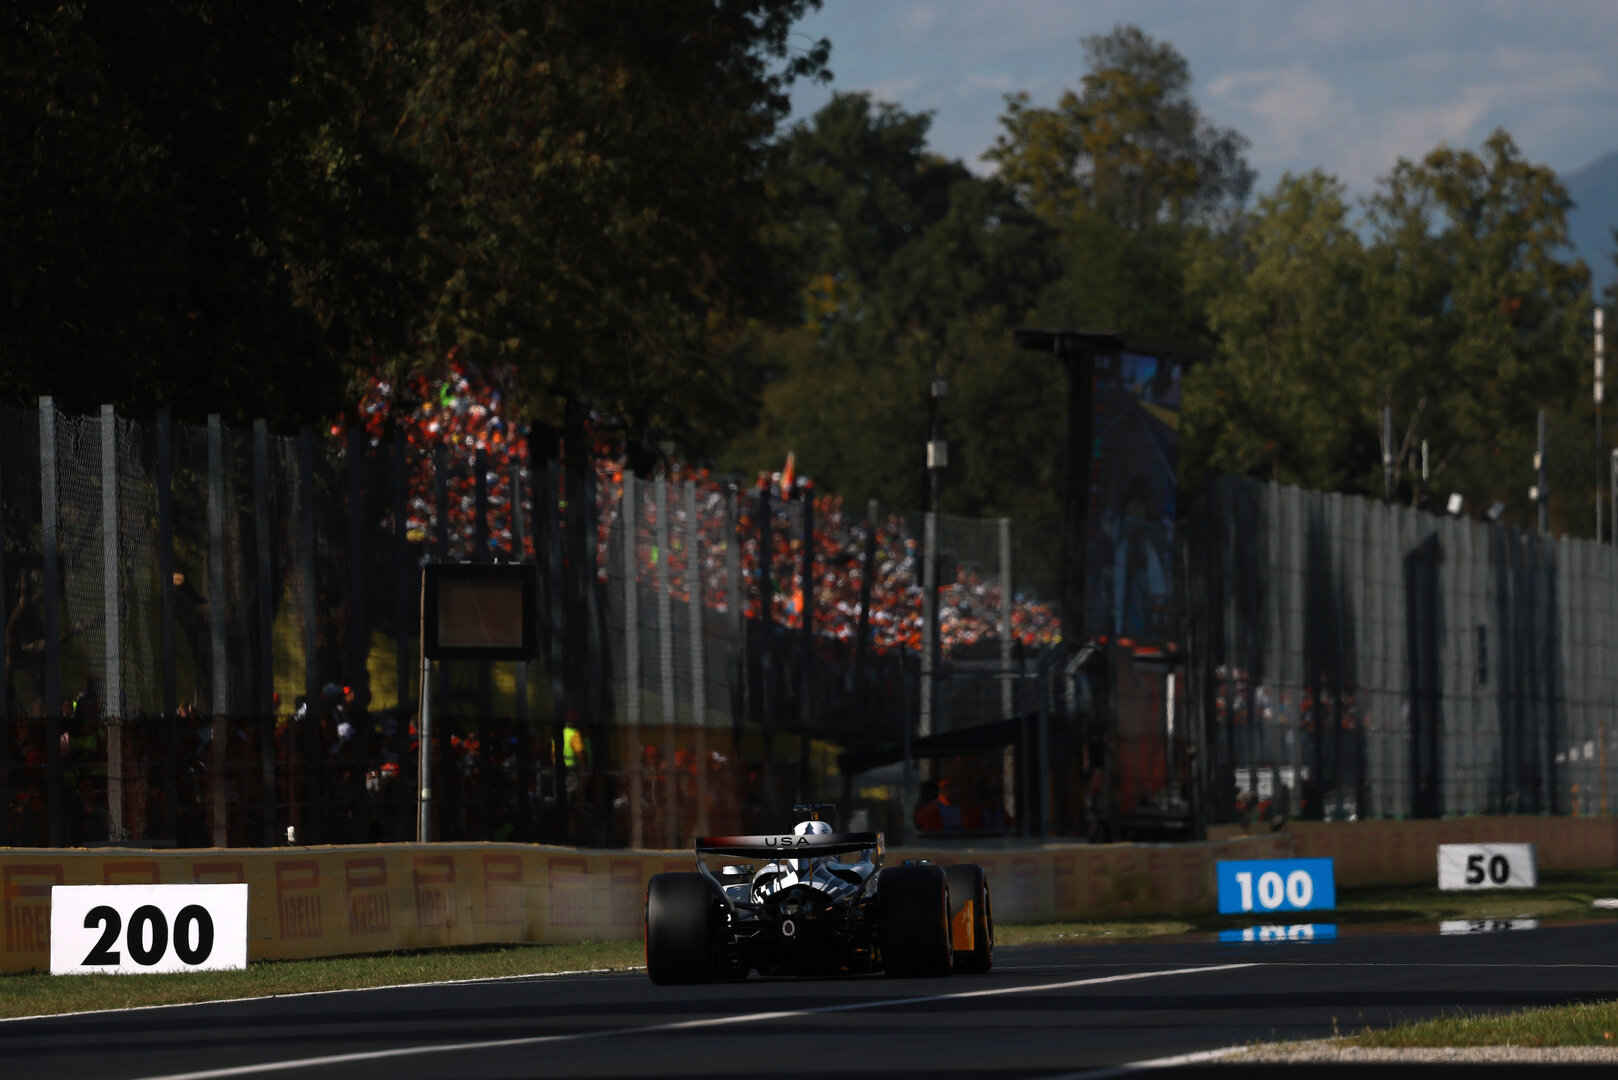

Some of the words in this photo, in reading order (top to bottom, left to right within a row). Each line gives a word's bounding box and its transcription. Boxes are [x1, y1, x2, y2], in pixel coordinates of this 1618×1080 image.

[764, 836, 810, 847] USA
[1235, 869, 1314, 912] 100
[1466, 855, 1510, 884] 50
[275, 859, 323, 941] PIRELLI
[80, 904, 214, 966] 200
